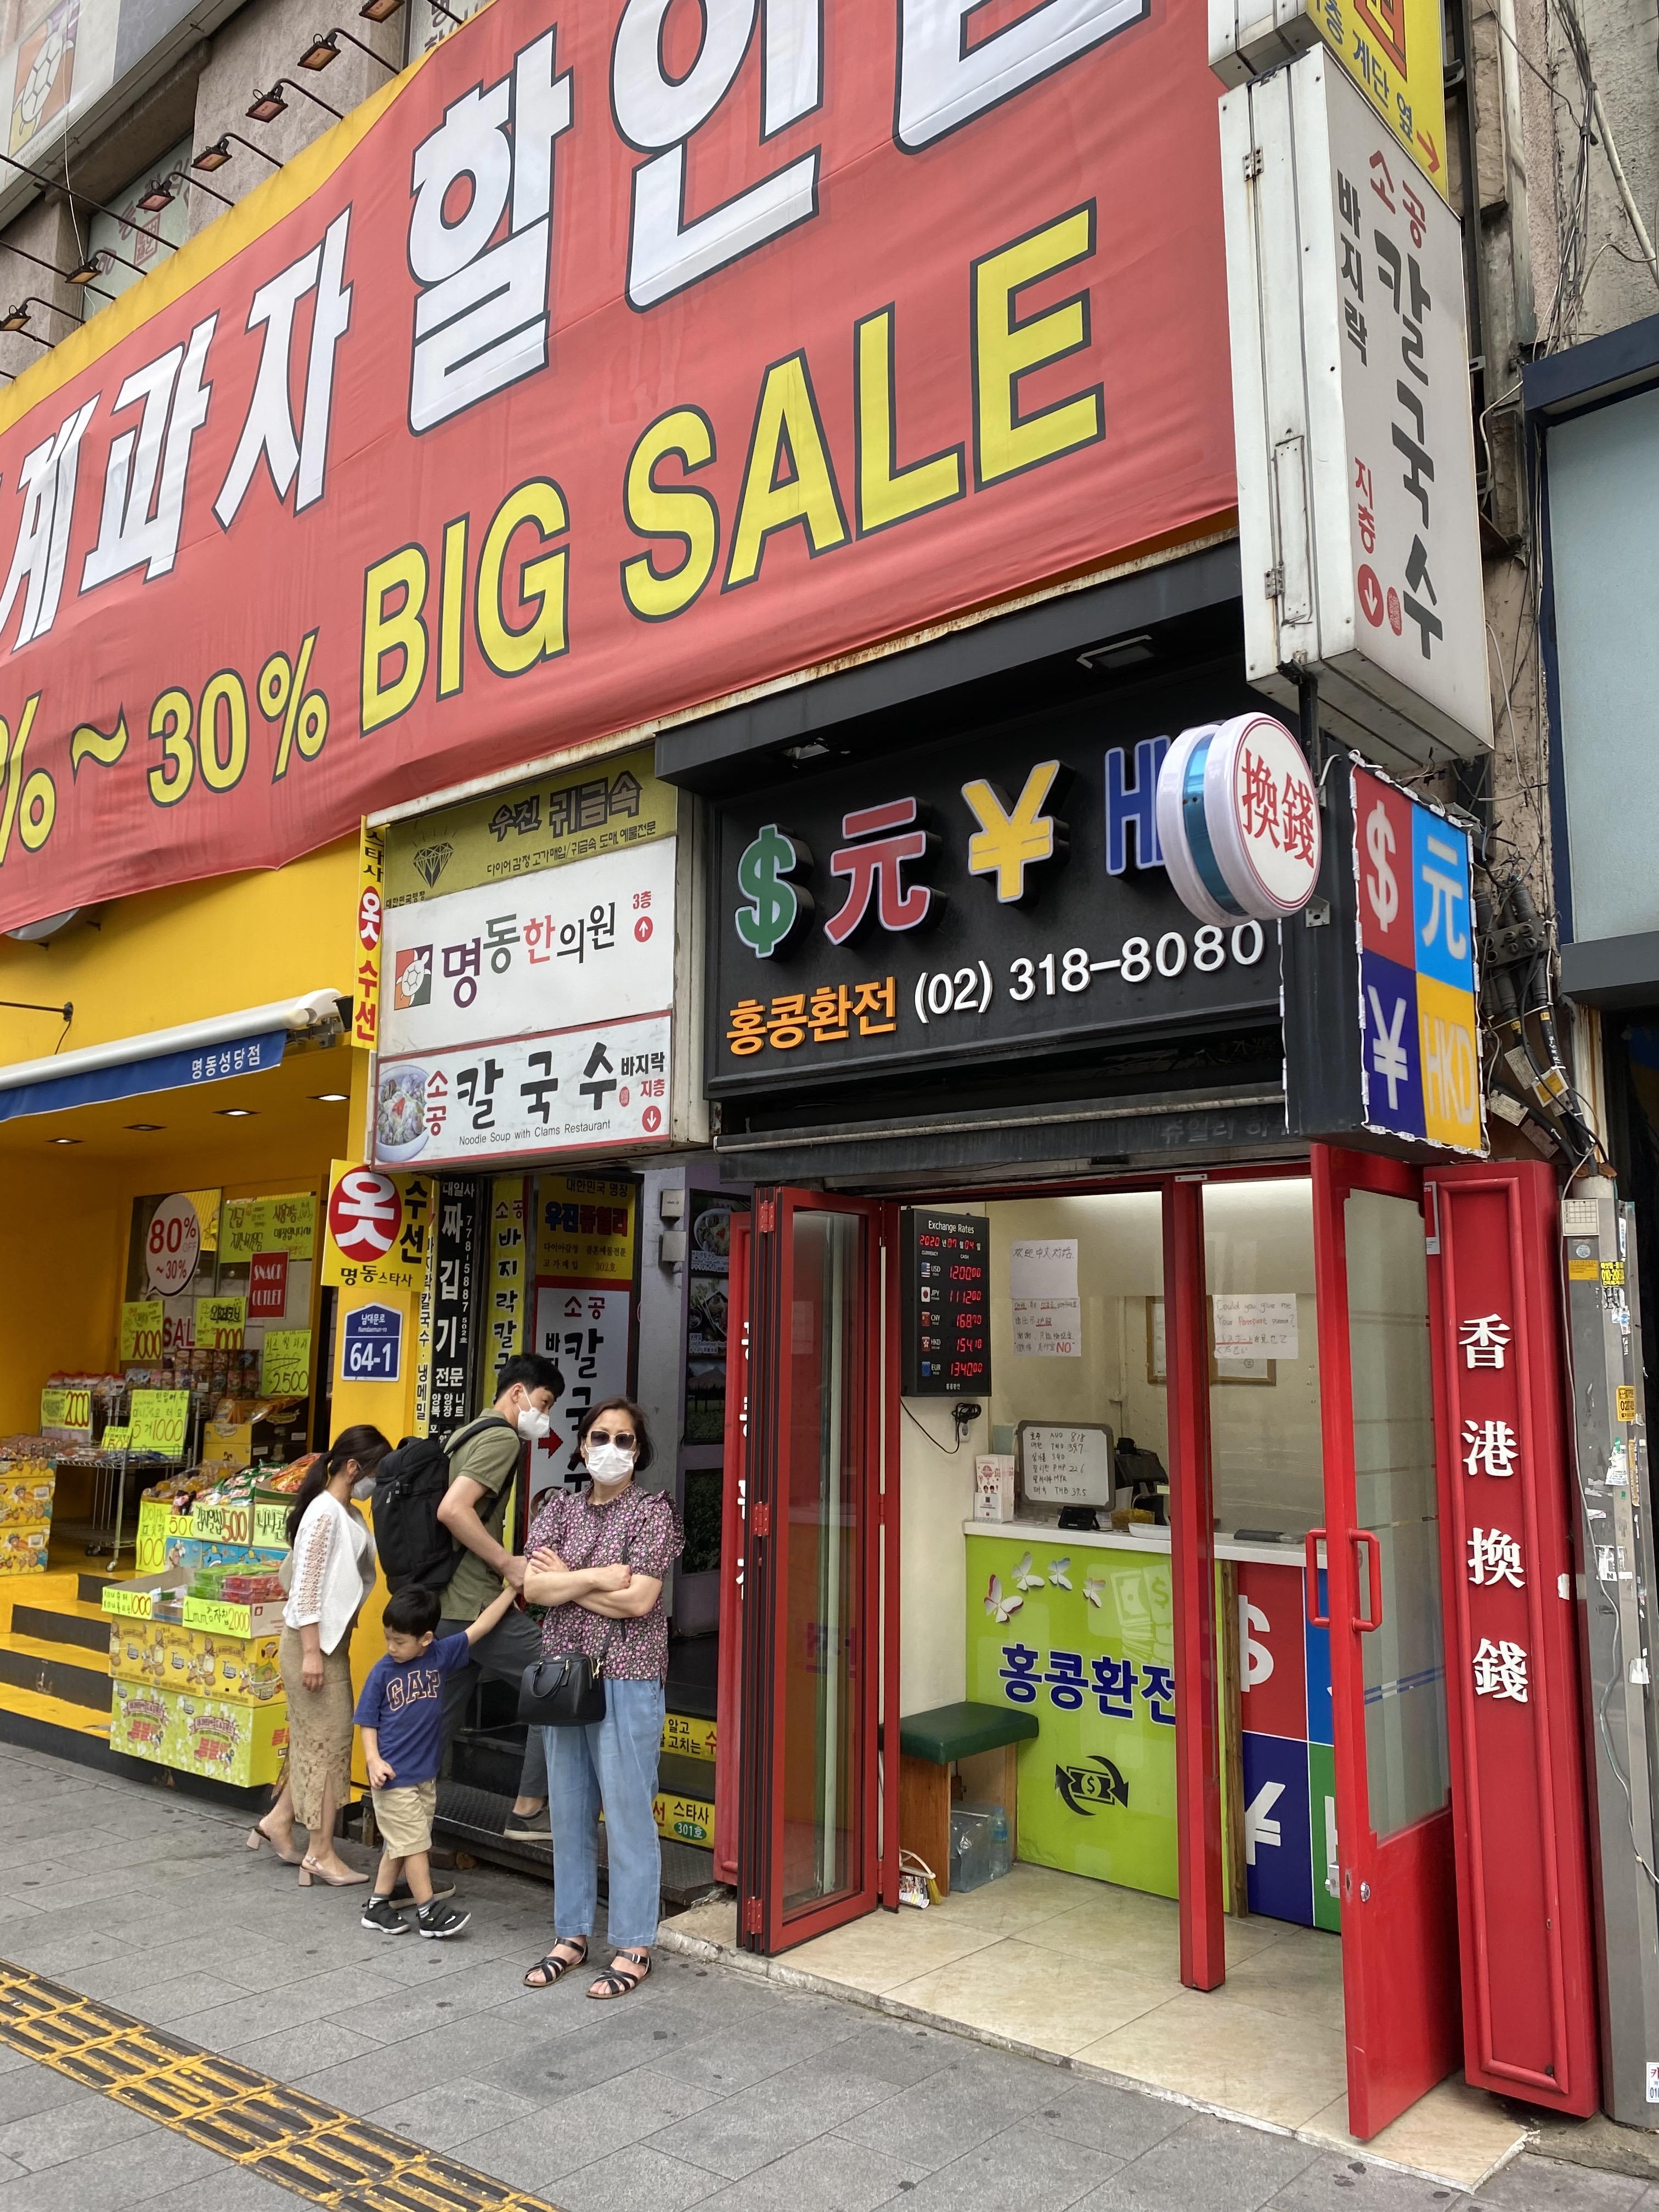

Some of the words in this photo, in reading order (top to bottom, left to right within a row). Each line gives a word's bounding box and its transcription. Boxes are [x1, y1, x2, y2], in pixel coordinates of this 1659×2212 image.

[1316, 0, 1344, 45] 층
[1352, 29, 1389, 109] 계단
[1397, 91, 1414, 145] 옆
[1369, 150, 1427, 250] 소공
[1337, 167, 1368, 368] 바지락
[0, 203, 356, 653] 계과자
[1374, 228, 1443, 661] 칼국수
[147, 625, 329, 808] 30%
[360, 476, 571, 738] BIG
[620, 198, 1106, 623] SALE
[1355, 456, 1376, 554] 지층
[488, 794, 543, 843] 우진
[549, 770, 644, 838] 귀금속
[1104, 734, 1173, 877] H
[1240, 747, 1316, 869] 換錢
[824, 795, 932, 946] 元
[632, 890, 652, 910] 3층
[1422, 834, 1468, 961] 元
[360, 891, 380, 946] 옷
[441, 901, 616, 1008] 명동한의원
[355, 960, 378, 1042] 수선
[726, 975, 898, 1056] 홍콩환전
[915, 959, 993, 1025] (02)
[1008, 918, 1265, 1002] 318-8080
[191, 1042, 261, 1080] 명동성당점
[621, 1052, 665, 1077] 바지락
[1423, 1013, 1477, 1126] HKD
[456, 1042, 617, 1130] 칼국수
[640, 1079, 665, 1098] 지층
[426, 1070, 448, 1137] 소공
[459, 1131, 487, 1146] Noodle
[490, 1130, 511, 1143] Soup
[514, 1126, 531, 1139] with
[534, 1123, 561, 1138] Clams
[565, 1119, 611, 1133] Restaurant
[442, 1181, 476, 1198] 대일사
[566, 1178, 605, 1195] 대한민국
[610, 1182, 628, 1198] 명장
[335, 1171, 396, 1252] 옷
[399, 1180, 428, 1265] 수선
[149, 1215, 196, 1255] 80%
[919, 1234, 940, 1247] 2020
[928, 1220, 957, 1234] Exchange
[958, 1223, 975, 1234] Rates
[166, 1259, 187, 1279] 30%
[253, 1263, 283, 1281] SNACK
[251, 1289, 283, 1307] OUTLET
[564, 1295, 605, 1321] 소공
[1216, 1300, 1240, 1311] Could
[1244, 1303, 1257, 1313] you
[1260, 1302, 1276, 1313] give
[163, 1318, 195, 1347] SAL
[361, 1313, 386, 1325] 남대문로
[1217, 1314, 1234, 1327] Your
[350, 1342, 391, 1372] 64-1
[931, 1363, 941, 1372] EUR
[269, 1370, 309, 1394] 2500
[435, 1367, 464, 1387] 전문
[64, 1391, 89, 1427] 2000
[153, 1419, 183, 1442] 1000
[1458, 1312, 1530, 1704] 香港換錢
[222, 1508, 248, 1543] 500
[139, 1537, 165, 1567] 100
[131, 1593, 152, 1616] 1000
[228, 1607, 250, 1633] 2000
[386, 1669, 441, 1712] GAP
[669, 1718, 690, 1735] 알고
[668, 1735, 702, 1755] 고치는
[673, 1800, 709, 1826] 스타사
[677, 1821, 704, 1839] 301호
